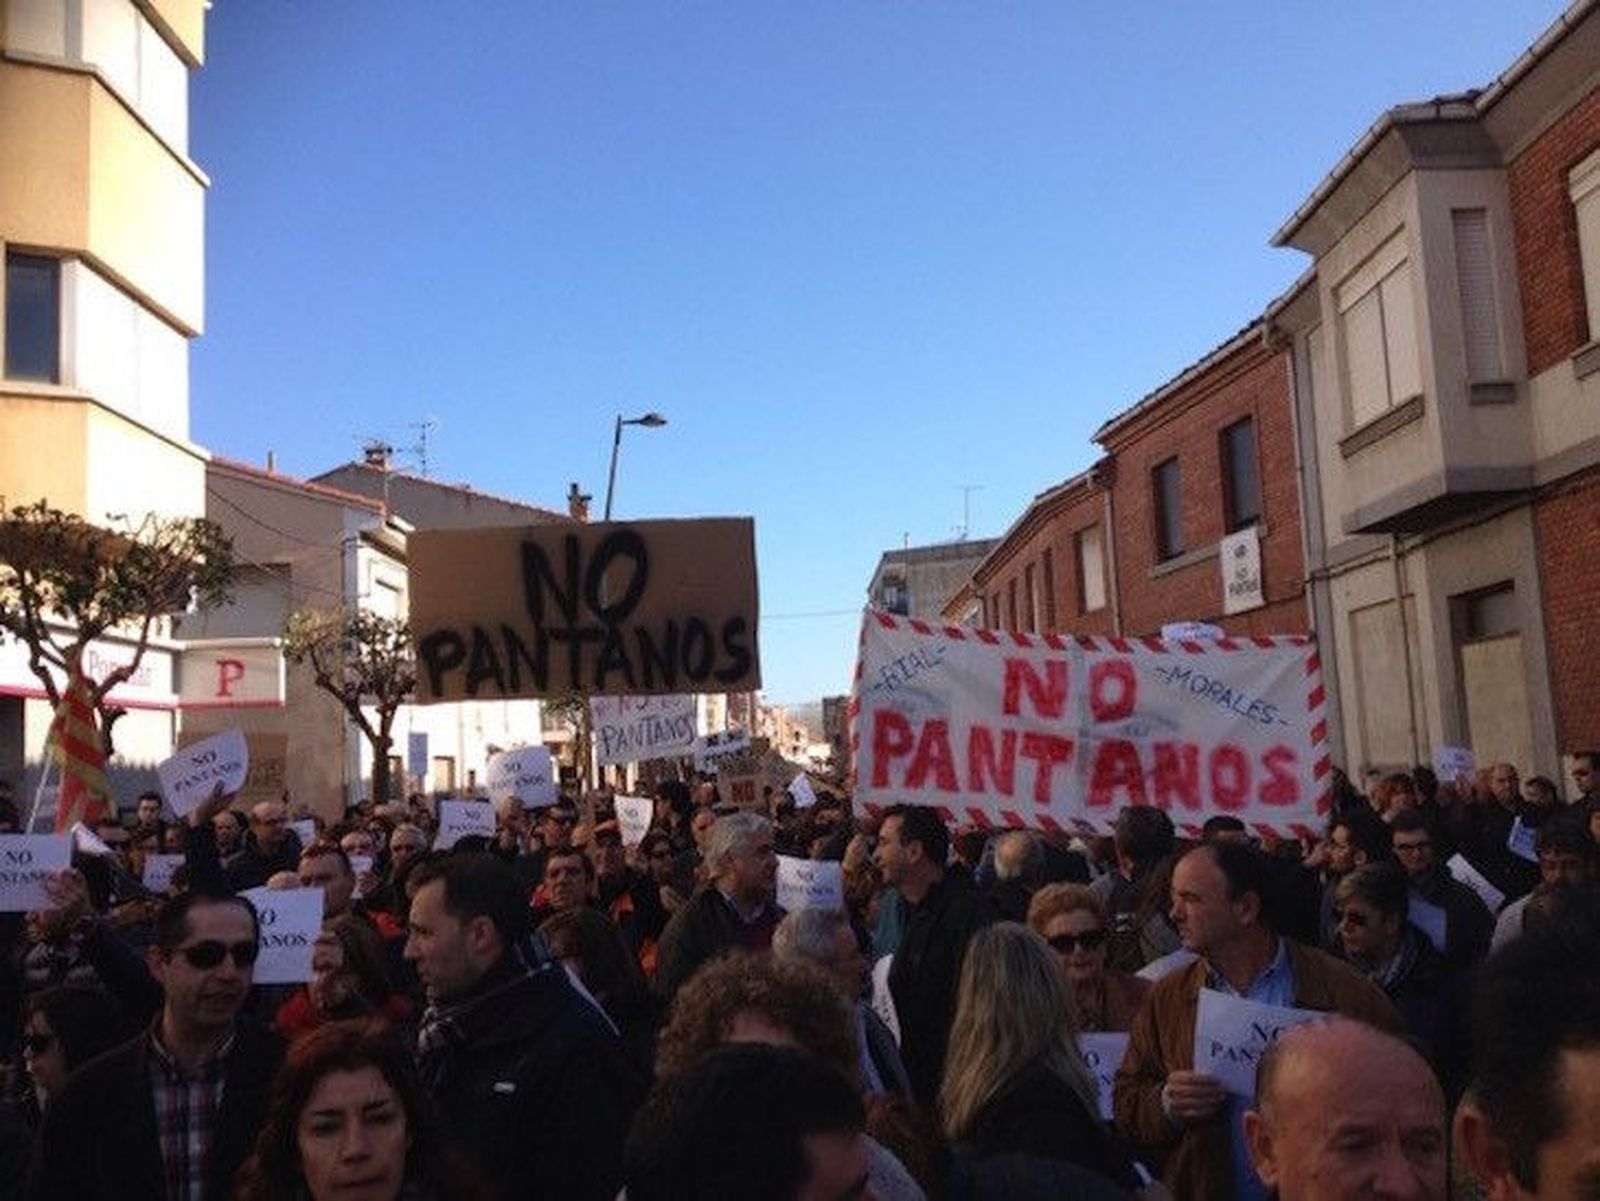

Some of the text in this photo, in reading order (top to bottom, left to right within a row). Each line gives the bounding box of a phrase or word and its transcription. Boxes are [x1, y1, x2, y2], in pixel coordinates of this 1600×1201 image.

[519, 529, 649, 624] NO
[215, 658, 245, 697] P
[419, 615, 752, 698] PANTANOS
[1001, 656, 1139, 723] NO
[191, 750, 217, 766] NO
[870, 709, 1302, 812] PANTANOS
[260, 909, 278, 926] O
